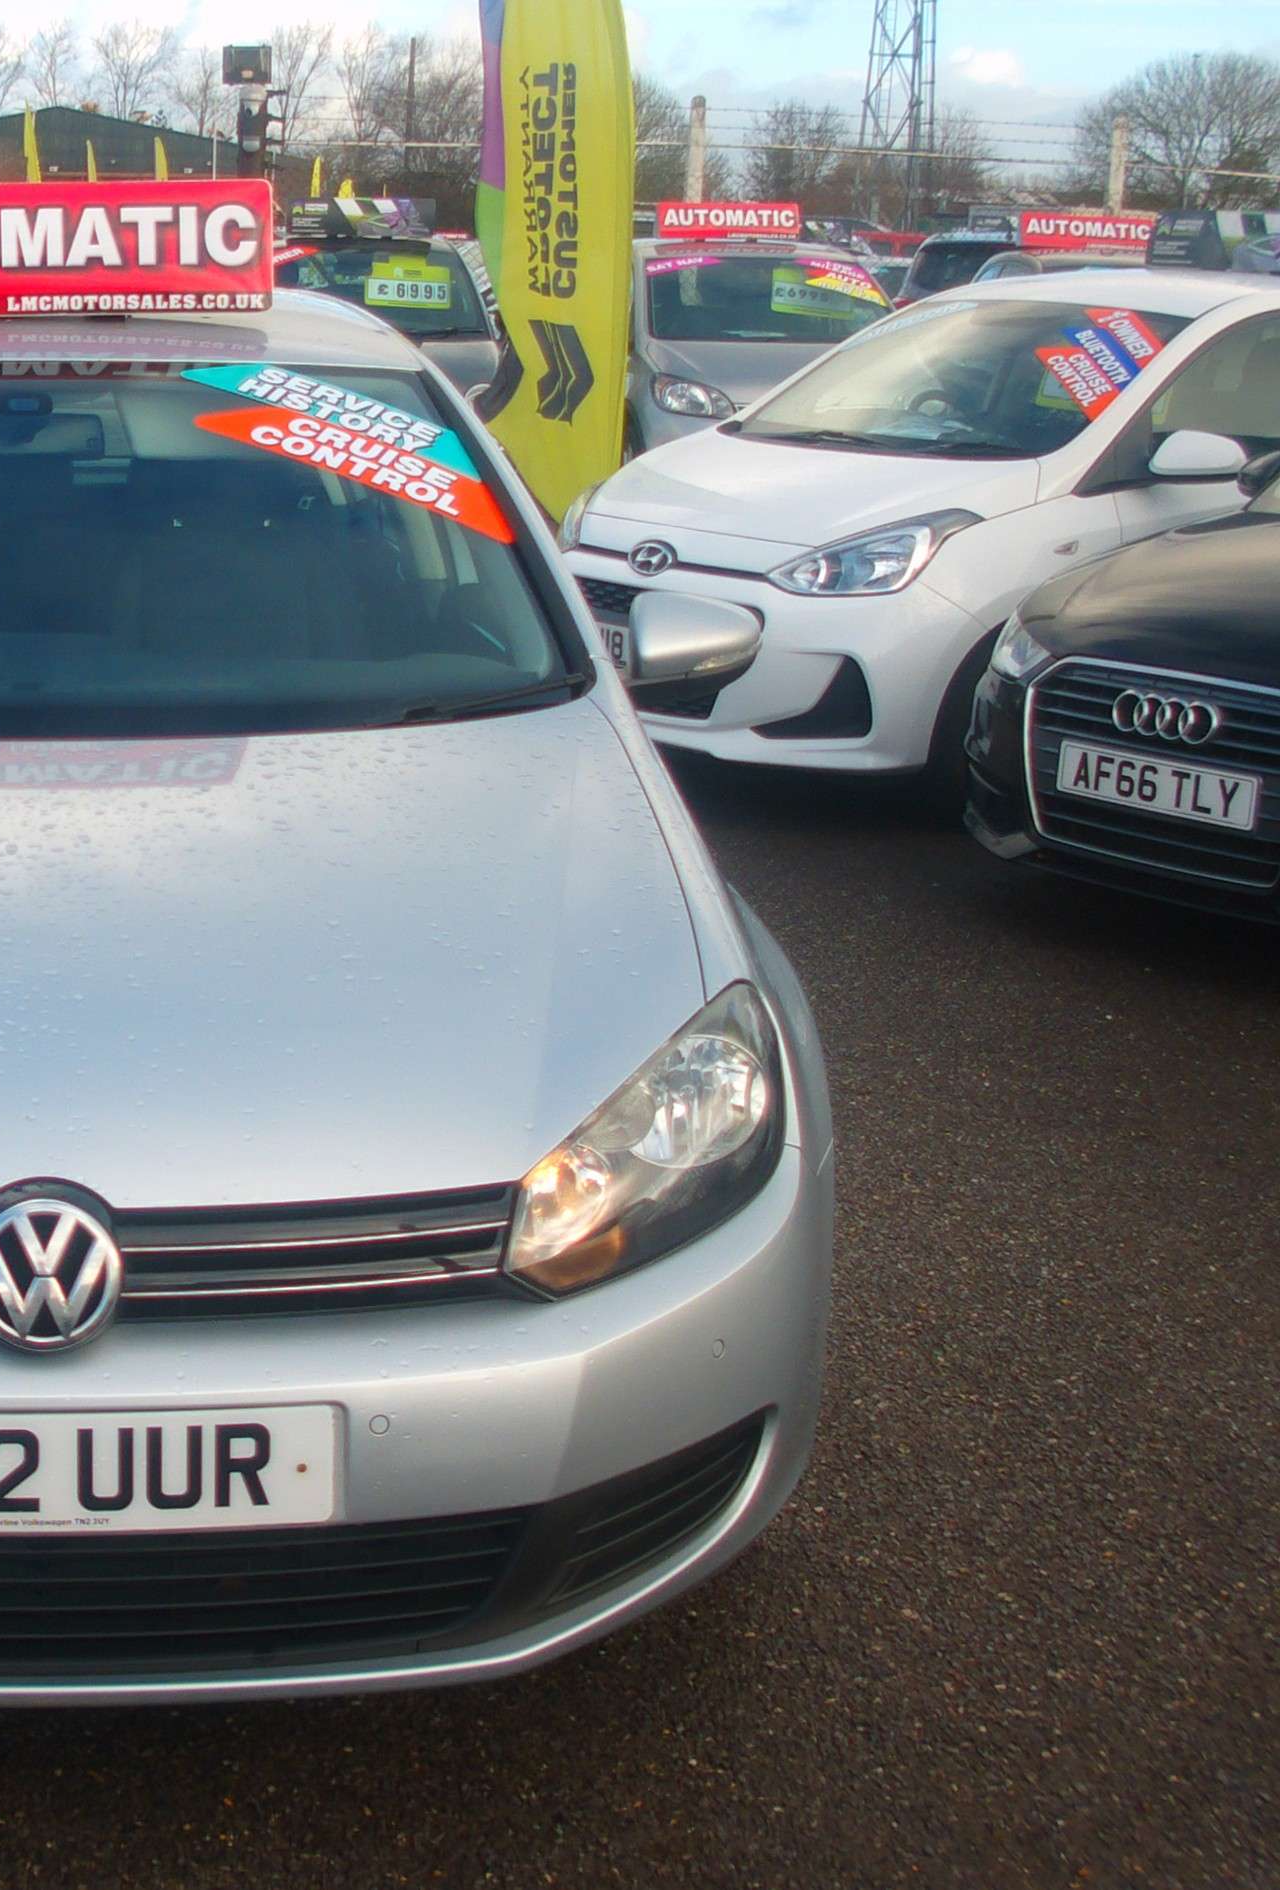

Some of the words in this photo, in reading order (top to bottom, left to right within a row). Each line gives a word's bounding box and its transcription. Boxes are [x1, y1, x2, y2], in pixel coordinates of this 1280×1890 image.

[663, 208, 796, 228] AUTOMATIC
[1026, 218, 1151, 240] AUTOMATIC
[6, 293, 265, 313] LMCMOTORSALES.CO.UK
[1074, 329, 1132, 384] BLUETOOTH
[1107, 318, 1155, 359] OWNER
[1047, 355, 1099, 408] CONTROL
[1068, 353, 1113, 396] CRUISE
[237, 377, 437, 453] HISTORY
[256, 367, 443, 442] SERVICE
[250, 425, 461, 516] CONTROL
[287, 417, 458, 490] CRUISE
[1072, 751, 1159, 802] AF66
[1171, 769, 1240, 818] TLY
[76, 1422, 272, 1512] UUR
